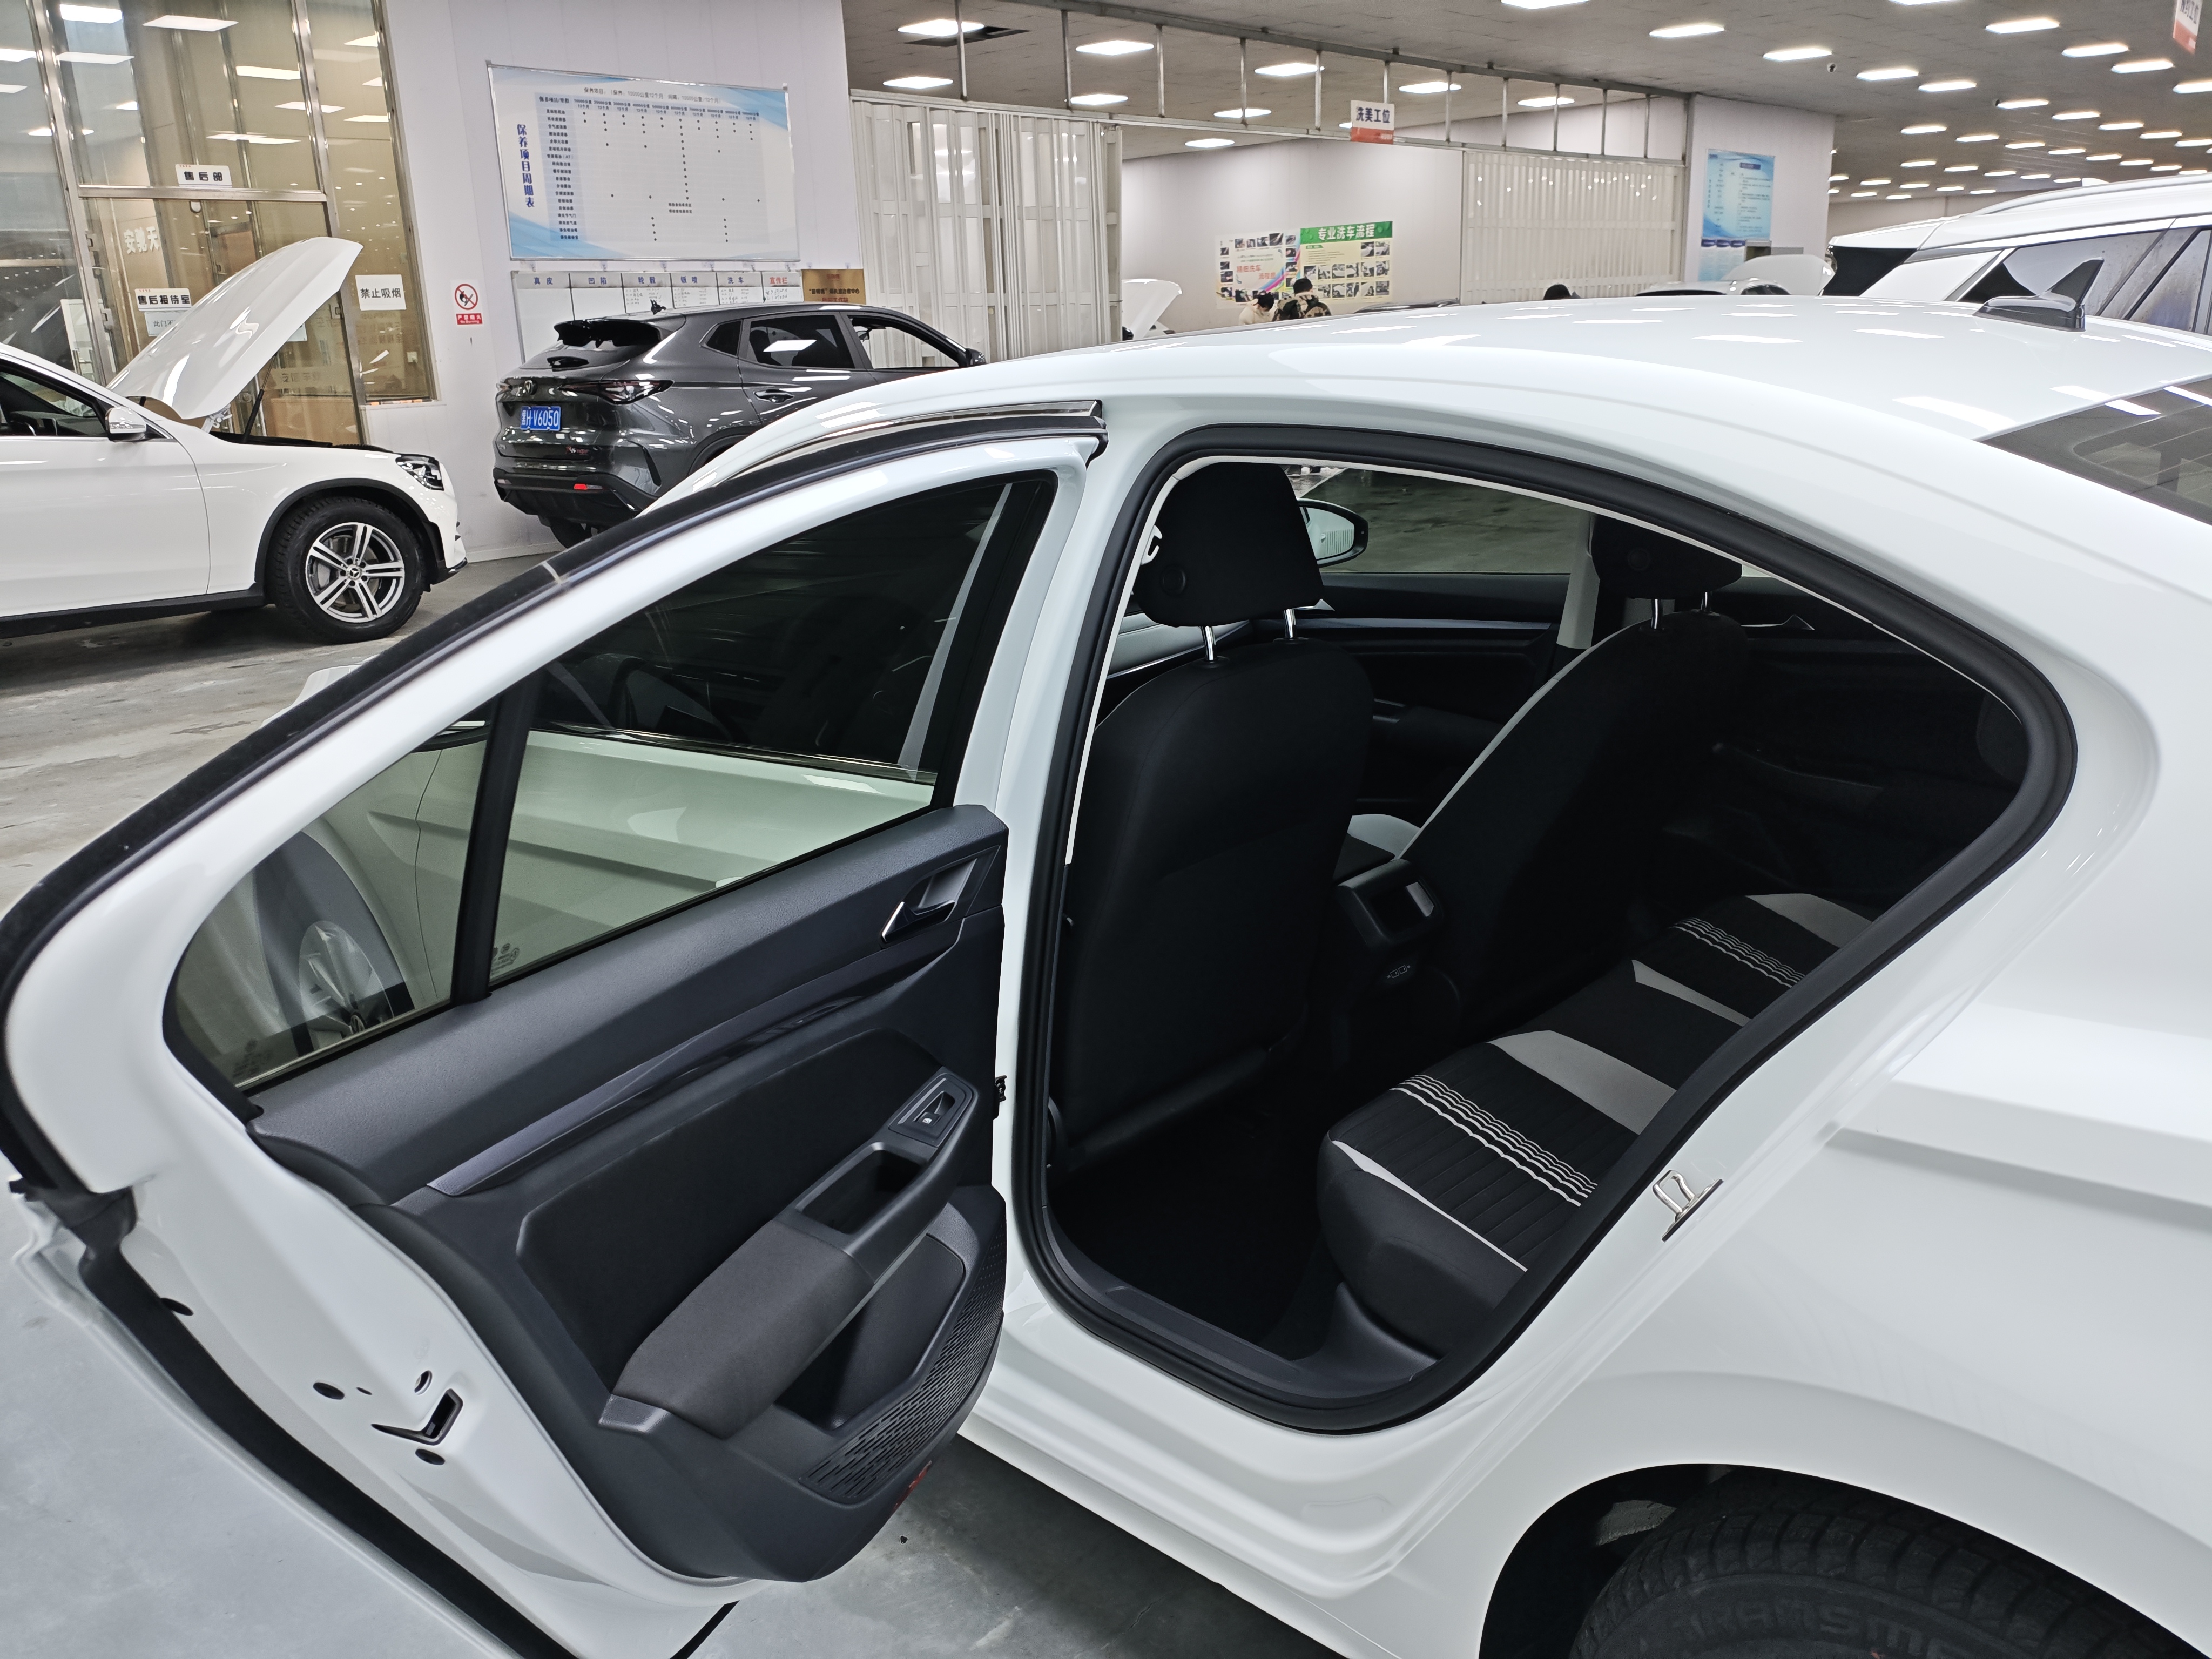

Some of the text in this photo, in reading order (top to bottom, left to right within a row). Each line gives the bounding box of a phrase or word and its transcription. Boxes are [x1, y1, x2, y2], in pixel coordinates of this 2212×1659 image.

[1356, 106, 1390, 123] 洗美工位
[517, 124, 535, 208] 保养项目周期表
[184, 171, 223, 181] 售后部
[1318, 224, 1375, 241] 专业洗车流程
[727, 276, 744, 284] 洗车
[360, 287, 402, 299] 禁止吸烟
[137, 295, 191, 305] 售后接待室
